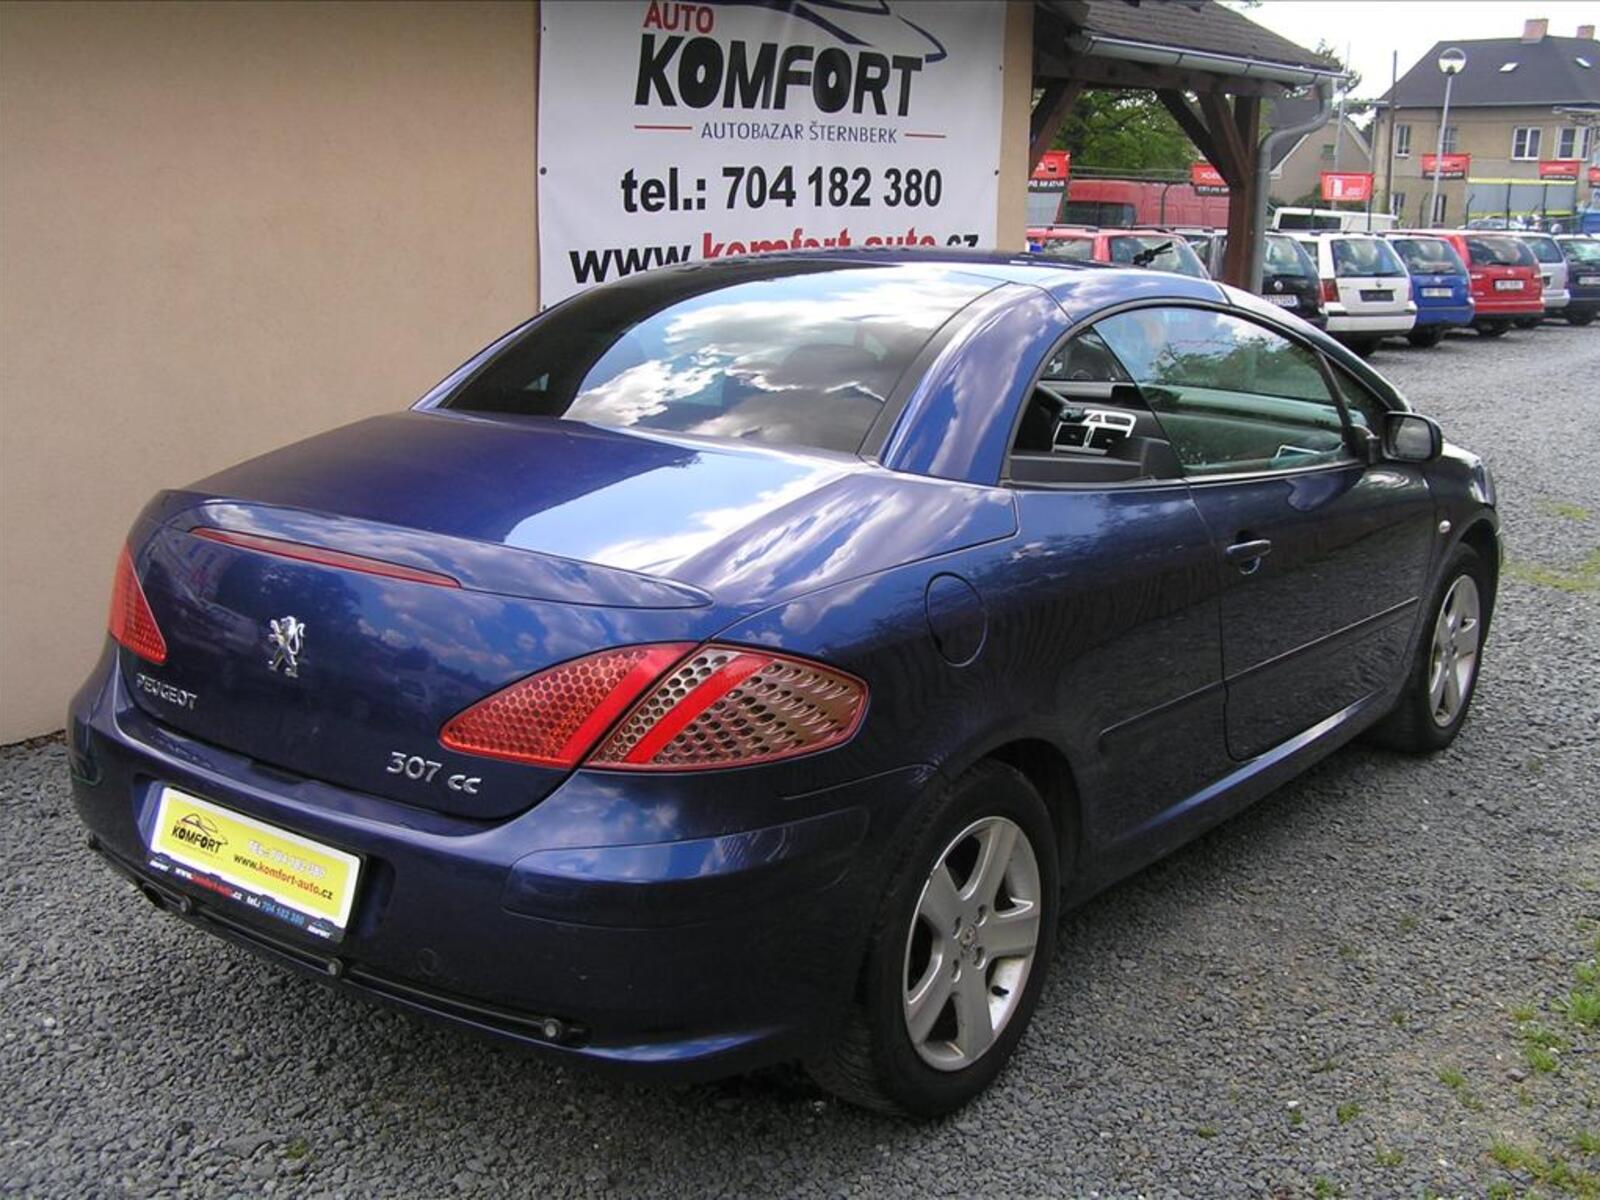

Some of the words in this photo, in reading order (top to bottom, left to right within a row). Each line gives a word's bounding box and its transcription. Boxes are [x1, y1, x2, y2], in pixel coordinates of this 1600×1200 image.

[644, 1, 714, 33] AUTO
[634, 33, 923, 117] KOMFORT
[701, 122, 804, 141] AUTOBAZAR
[809, 120, 898, 144] ŠTERNBERK
[620, 167, 706, 213] tel.:
[722, 165, 797, 210] 704
[807, 165, 872, 207] 182
[883, 167, 942, 207] 380
[136, 674, 198, 710] PEUGEOT
[386, 751, 442, 784] 307
[171, 825, 222, 854] KOMFORT
[234, 853, 334, 901] www.komfort-auto.cz
